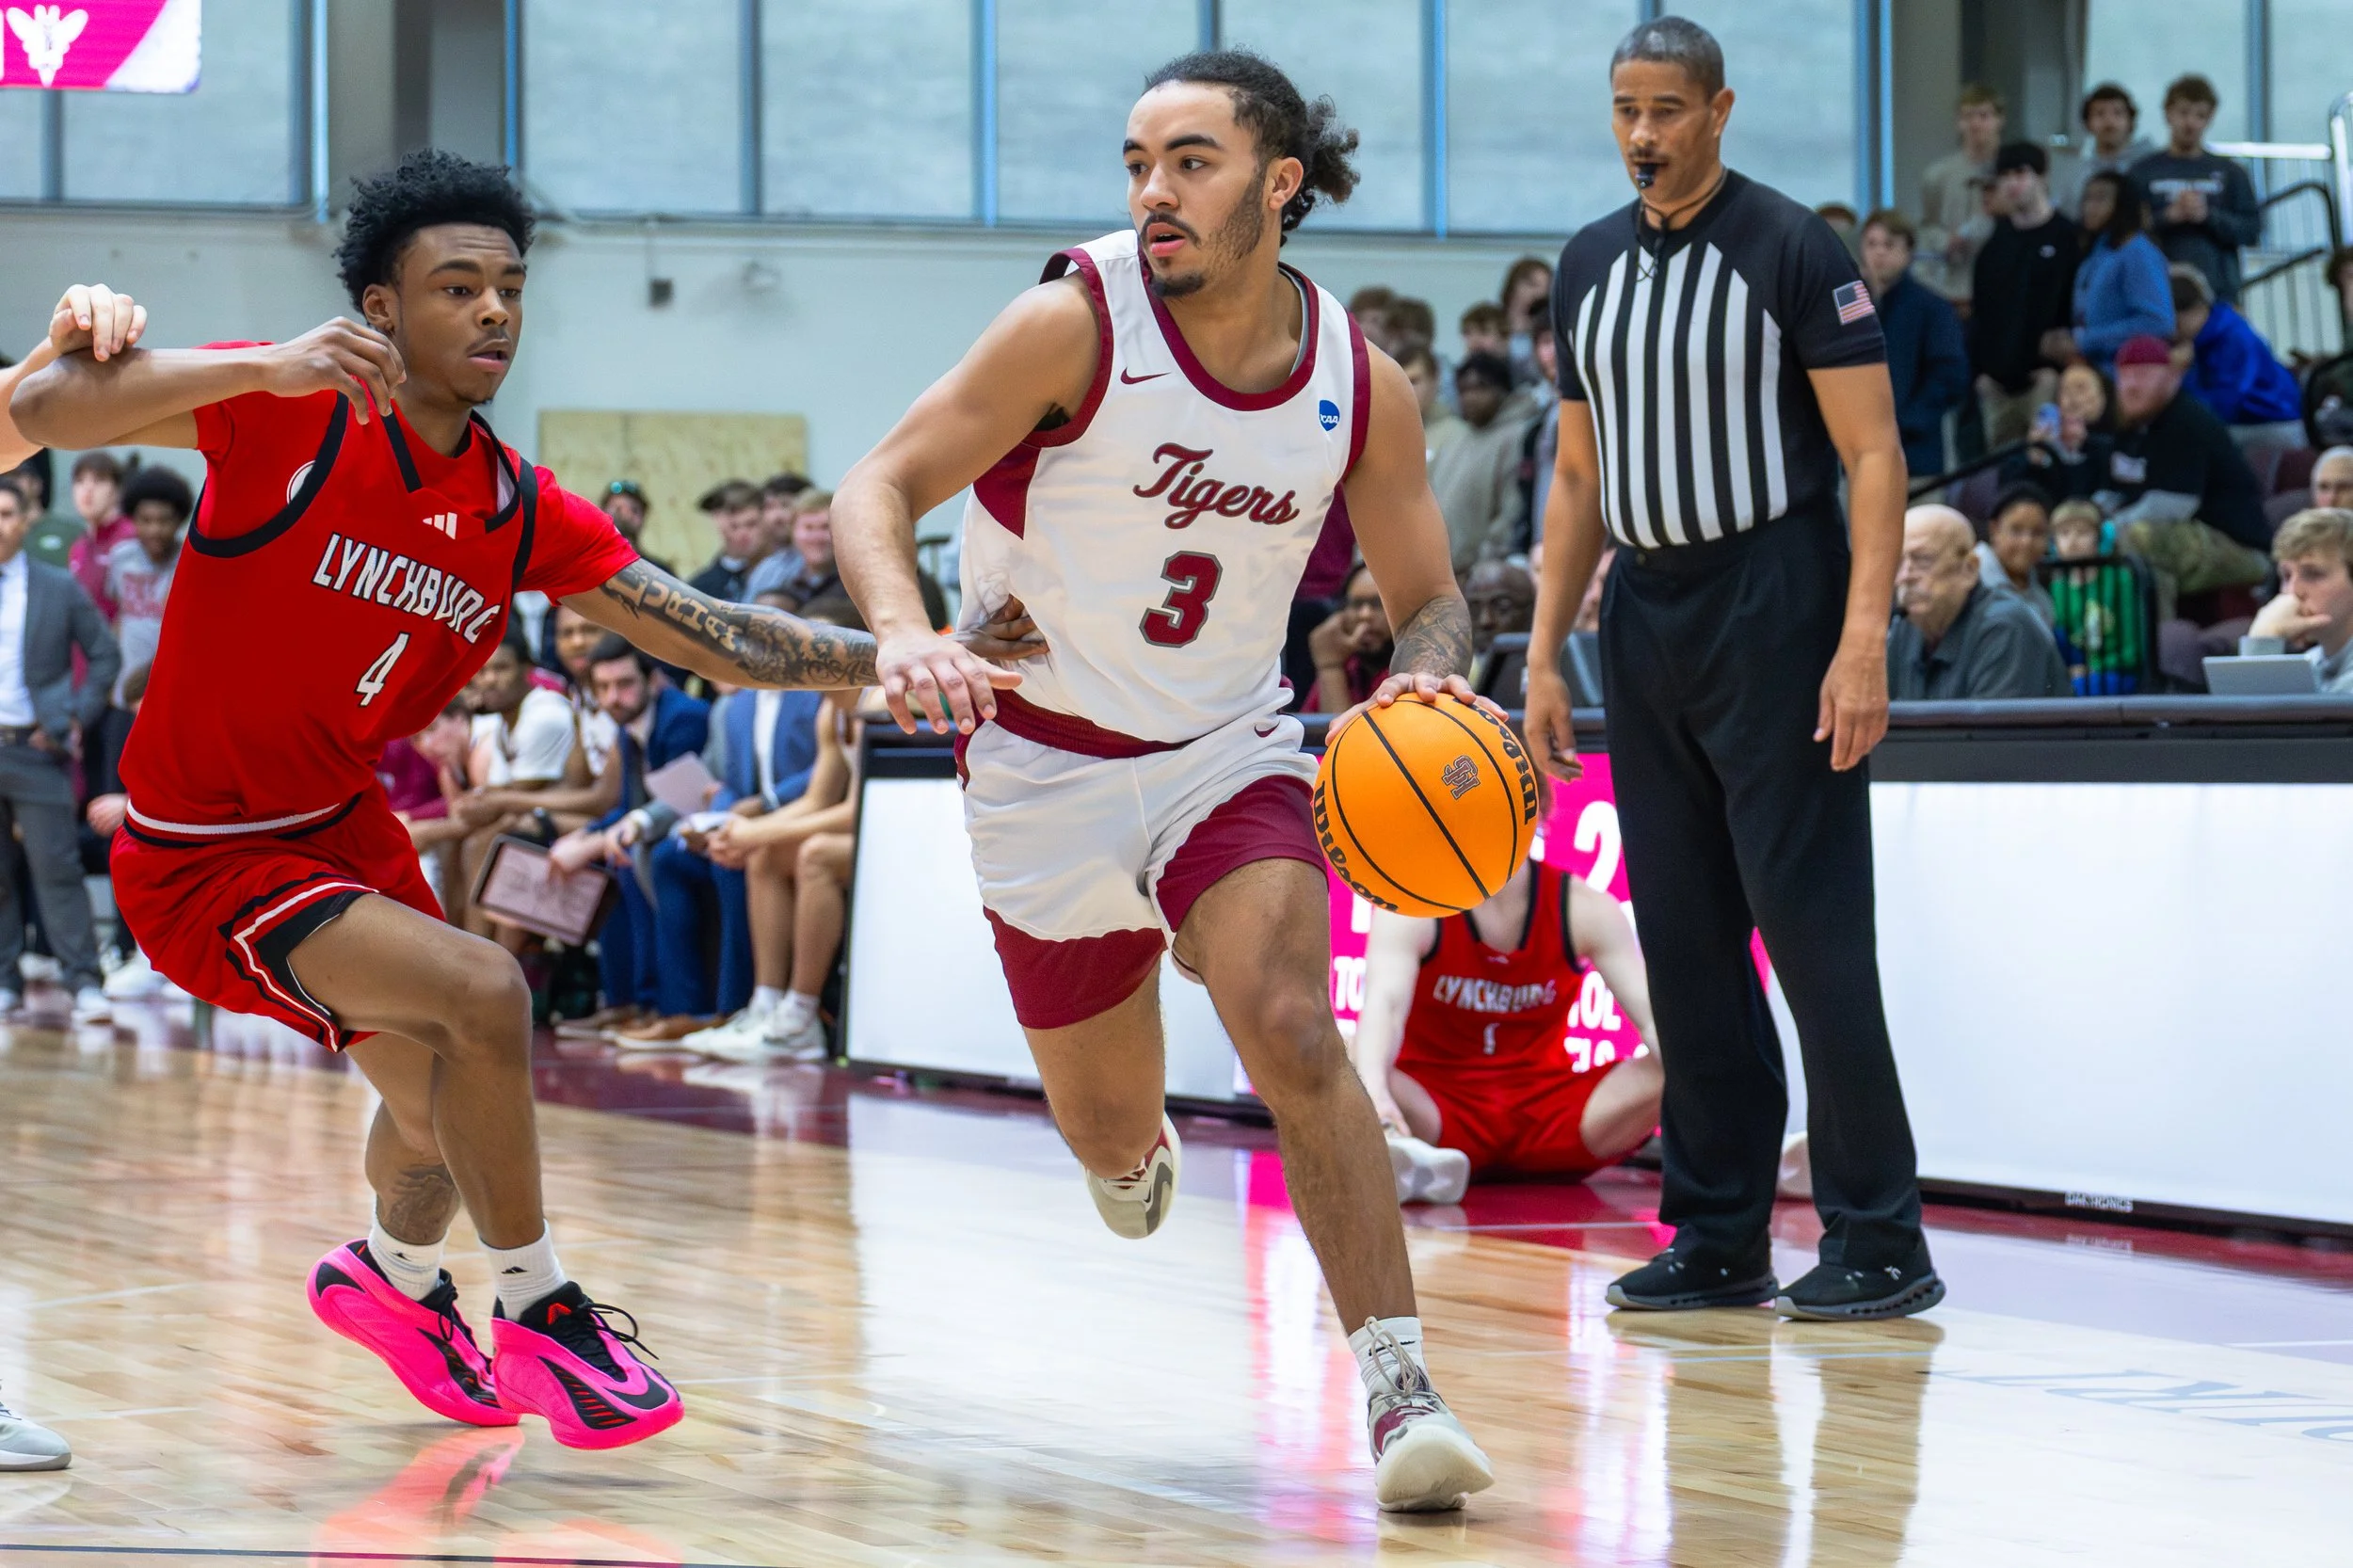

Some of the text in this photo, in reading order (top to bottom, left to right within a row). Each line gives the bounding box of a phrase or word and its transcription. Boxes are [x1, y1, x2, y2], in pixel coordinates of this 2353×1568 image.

[1132, 441, 1300, 529] Tigers
[312, 532, 501, 644] LYNCHBURG
[1139, 550, 1223, 648] 3
[354, 632, 411, 707] 4
[1313, 780, 1400, 913] Wilson
